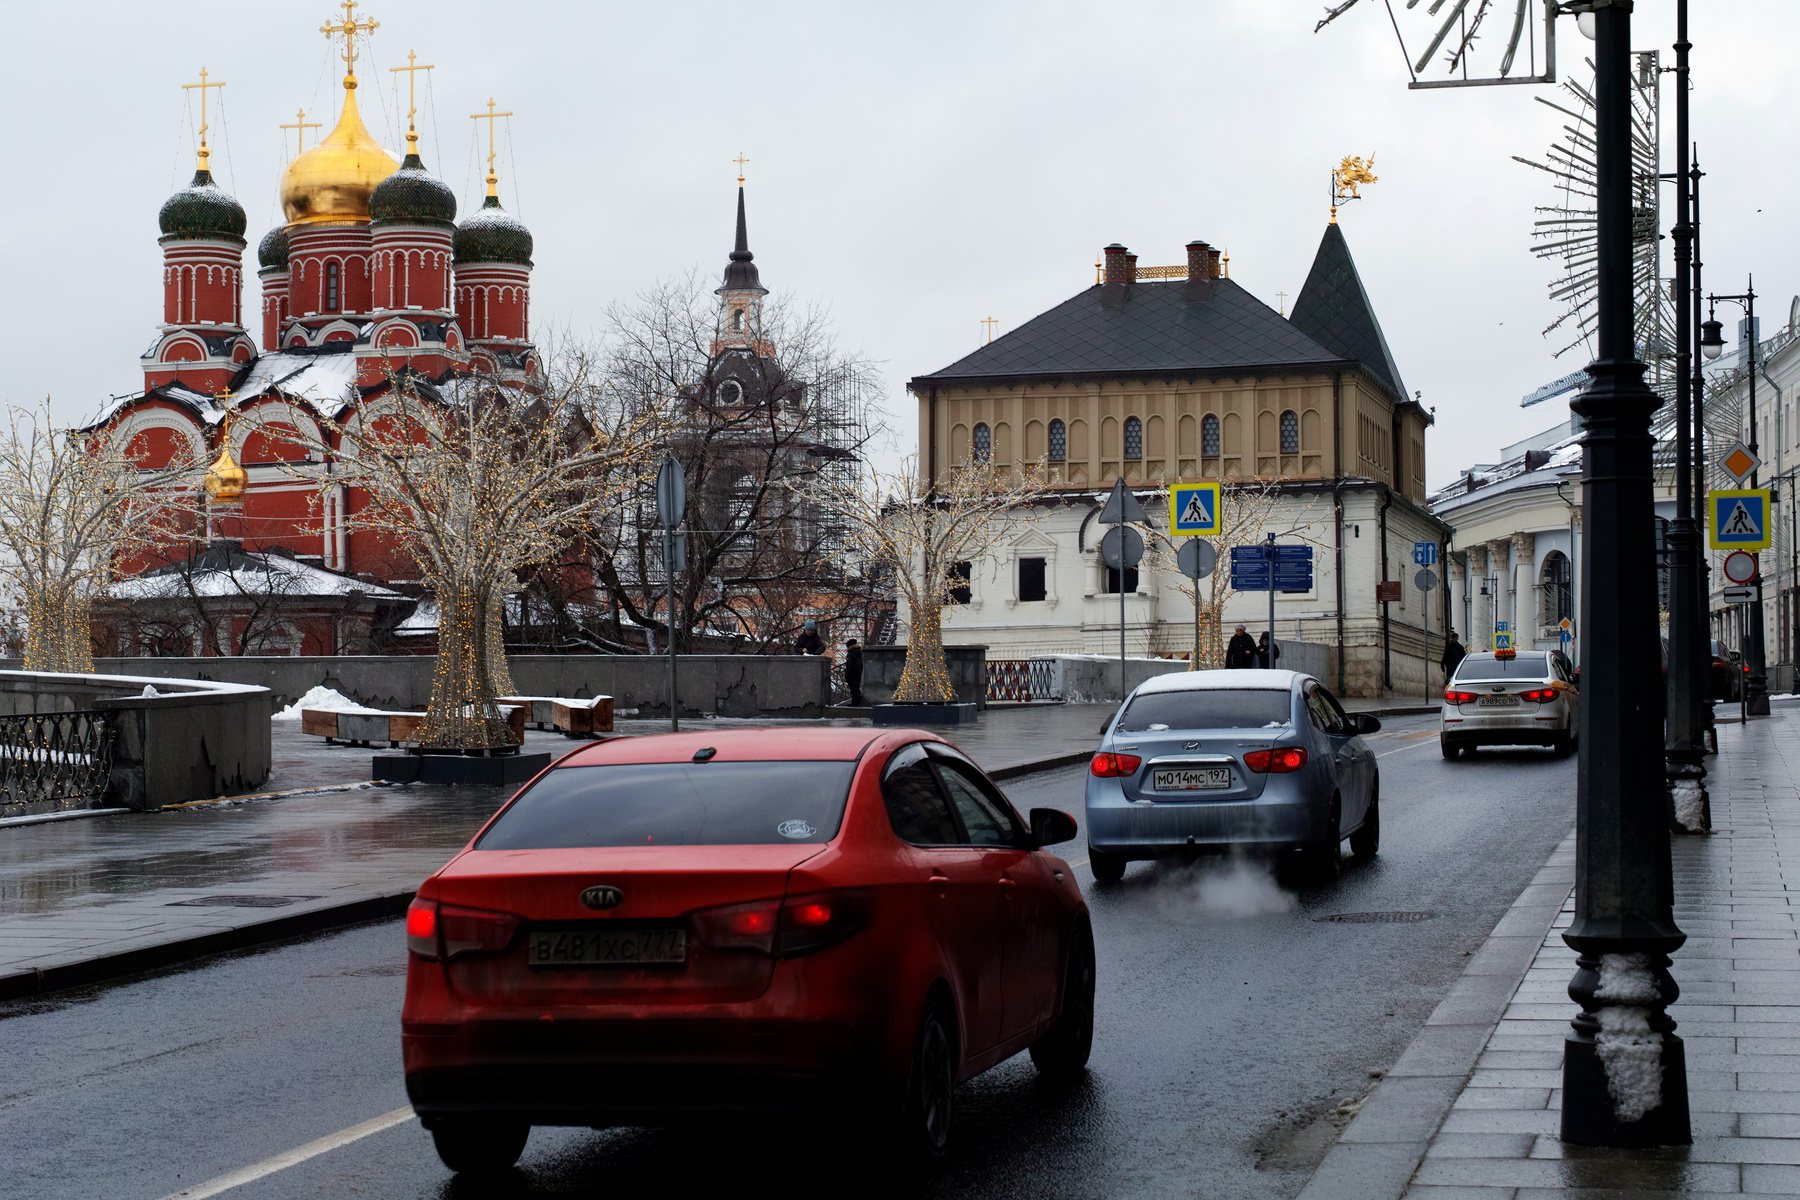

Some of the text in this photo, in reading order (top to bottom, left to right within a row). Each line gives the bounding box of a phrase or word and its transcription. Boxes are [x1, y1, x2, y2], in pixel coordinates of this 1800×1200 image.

[1157, 769, 1226, 785] М014МС 197
[586, 891, 617, 905] KIA
[537, 931, 679, 961] В481ХС 777
